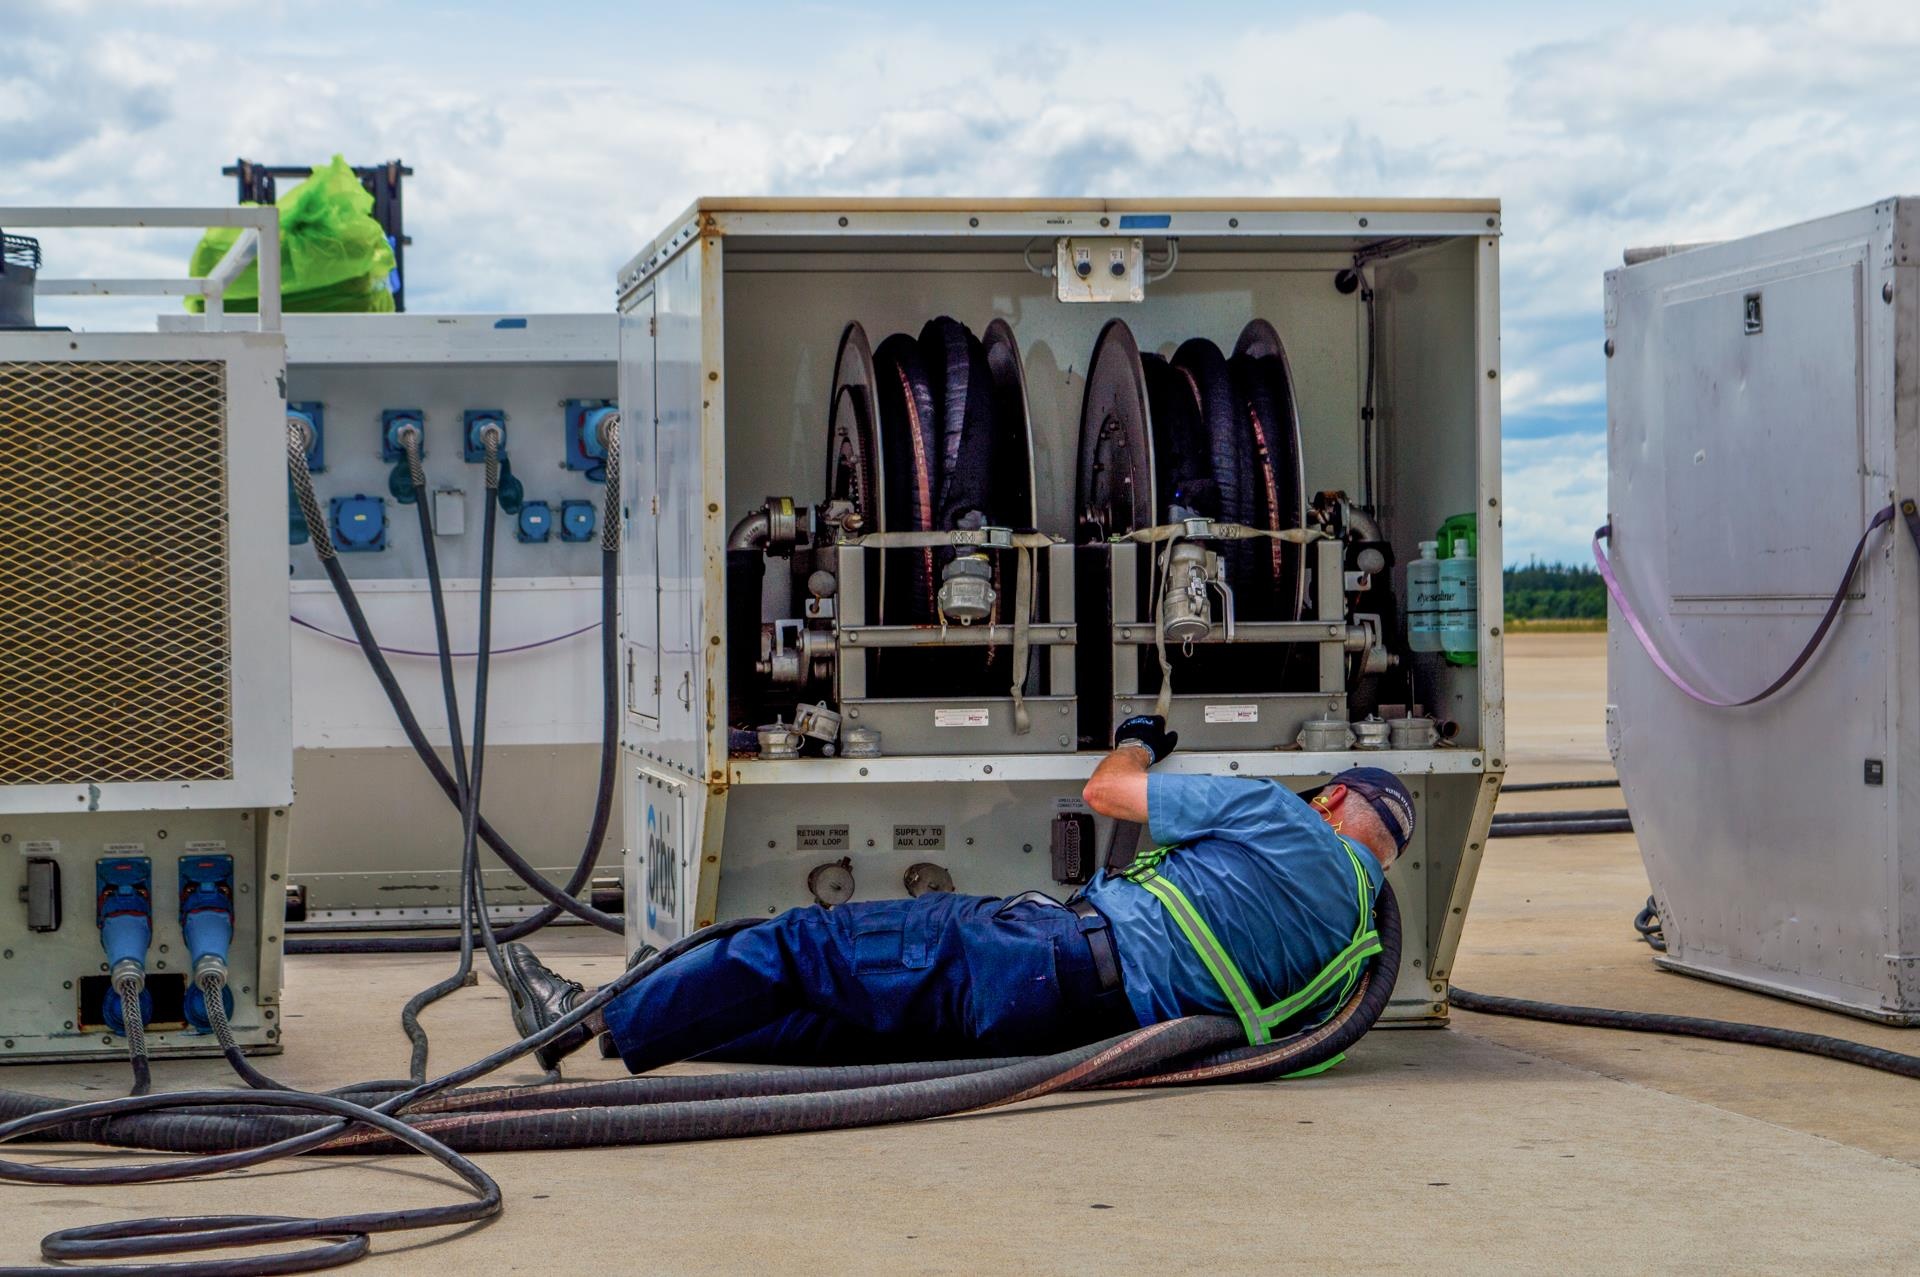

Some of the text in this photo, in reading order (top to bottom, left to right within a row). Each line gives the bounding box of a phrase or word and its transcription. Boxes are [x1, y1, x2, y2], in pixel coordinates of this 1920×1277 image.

[797, 829, 849, 837] RETURN FROM
[895, 828, 942, 836] SUPPLY TO
